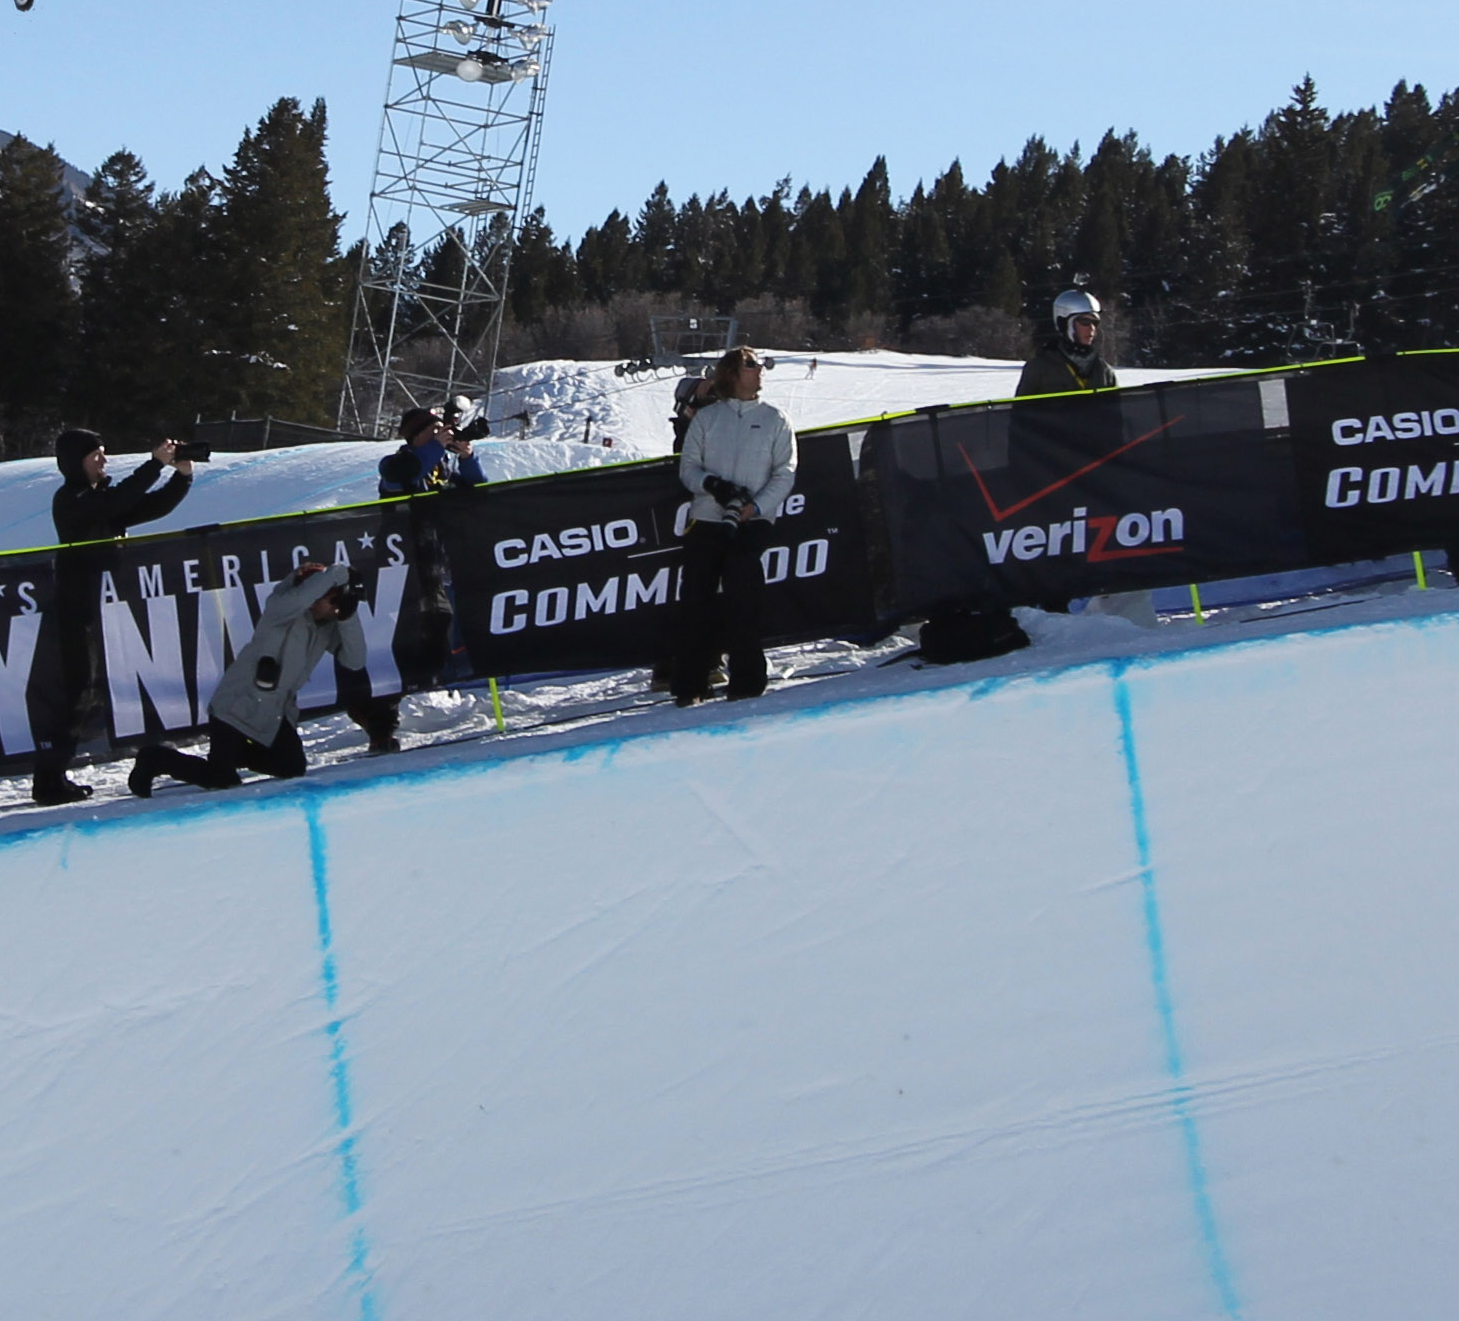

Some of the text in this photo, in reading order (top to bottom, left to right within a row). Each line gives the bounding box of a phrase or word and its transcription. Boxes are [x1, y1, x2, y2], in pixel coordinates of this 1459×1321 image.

[493, 518, 639, 569] CASIO
[982, 506, 1185, 564] verizon
[489, 538, 830, 636] COMMDO
